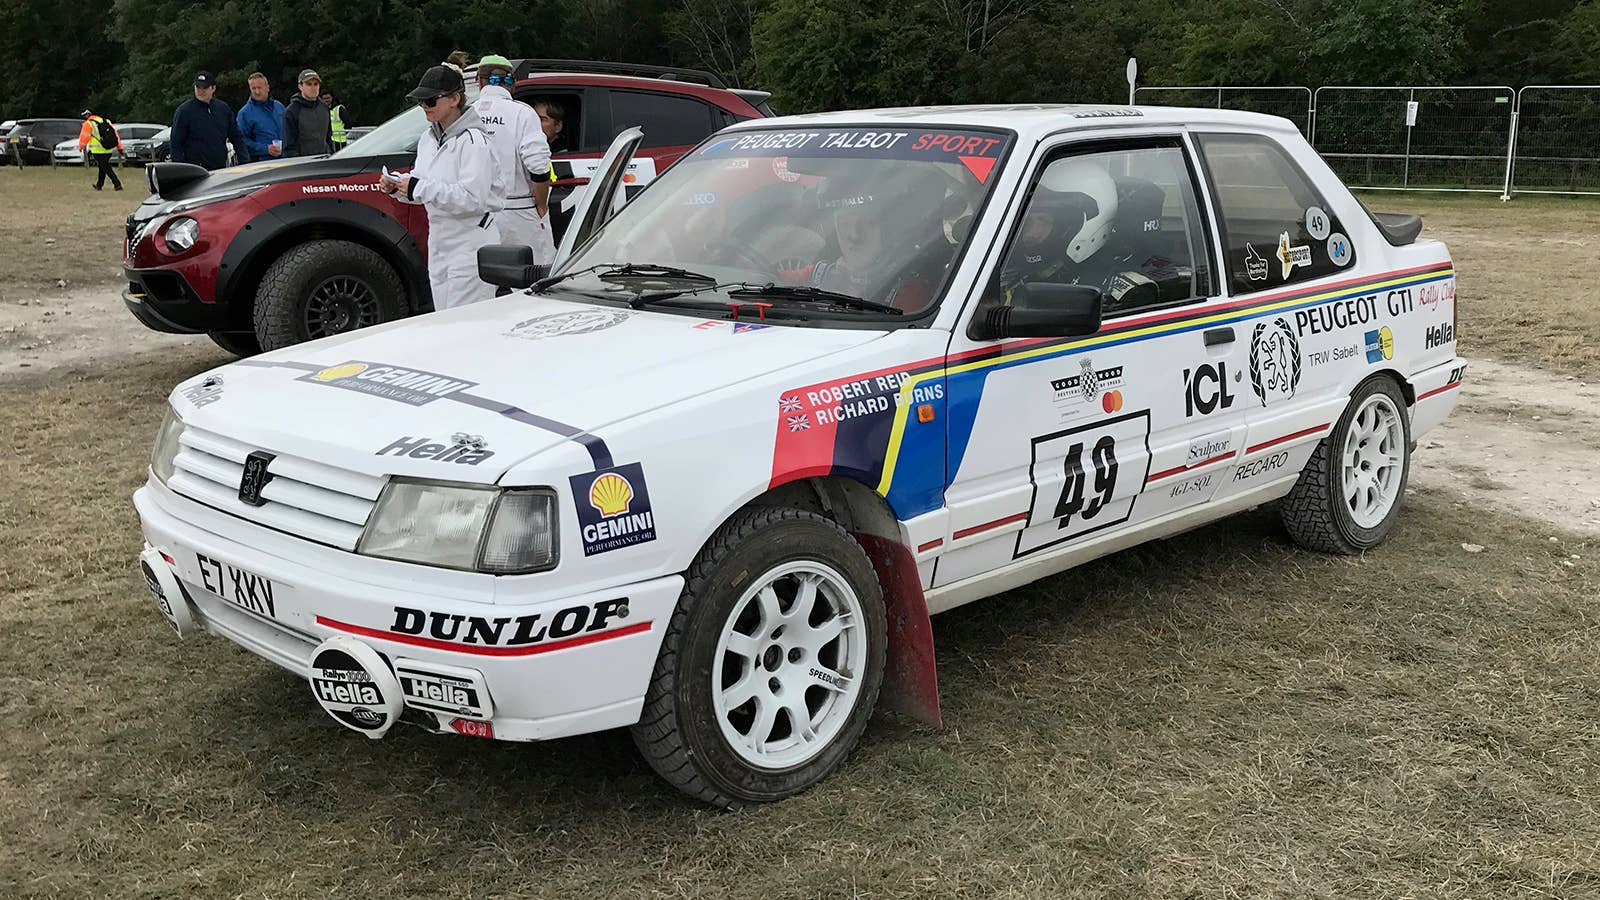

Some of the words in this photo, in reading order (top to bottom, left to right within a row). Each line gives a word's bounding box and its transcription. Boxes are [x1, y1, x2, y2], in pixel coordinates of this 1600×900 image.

[730, 133, 819, 151] PEUGEOT
[819, 132, 908, 150] TALBOT
[911, 133, 1000, 156] SPORT
[302, 185, 337, 194] Nissan
[339, 184, 368, 192] Motor
[1312, 216, 1323, 231] 49
[1419, 284, 1440, 312] Rally
[1295, 295, 1378, 338] PEUGEOT
[1387, 288, 1414, 317] GTI
[1425, 324, 1452, 350] Hella
[1308, 351, 1330, 368] TRW
[1332, 344, 1359, 362] Sabelt
[357, 366, 471, 397] GEMINI
[806, 380, 871, 407] ROBERT
[877, 371, 913, 393] REID
[1055, 378, 1078, 389] GOOD
[1098, 369, 1121, 379] WOOD
[815, 396, 890, 426] RICHARD
[895, 383, 944, 409] BURNS
[375, 436, 496, 466] Hella
[1188, 439, 1231, 460] Sculptor
[1233, 451, 1289, 482] RECARO
[1053, 435, 1119, 530] 49
[583, 511, 653, 544] GEMINI
[586, 534, 641, 554] PERFORMANCE
[196, 552, 225, 597] E7
[228, 565, 276, 618] XKV
[390, 596, 629, 646] DUNLOP
[322, 668, 346, 680] Rallye
[318, 680, 379, 704] Hella
[411, 678, 470, 706] Hella
